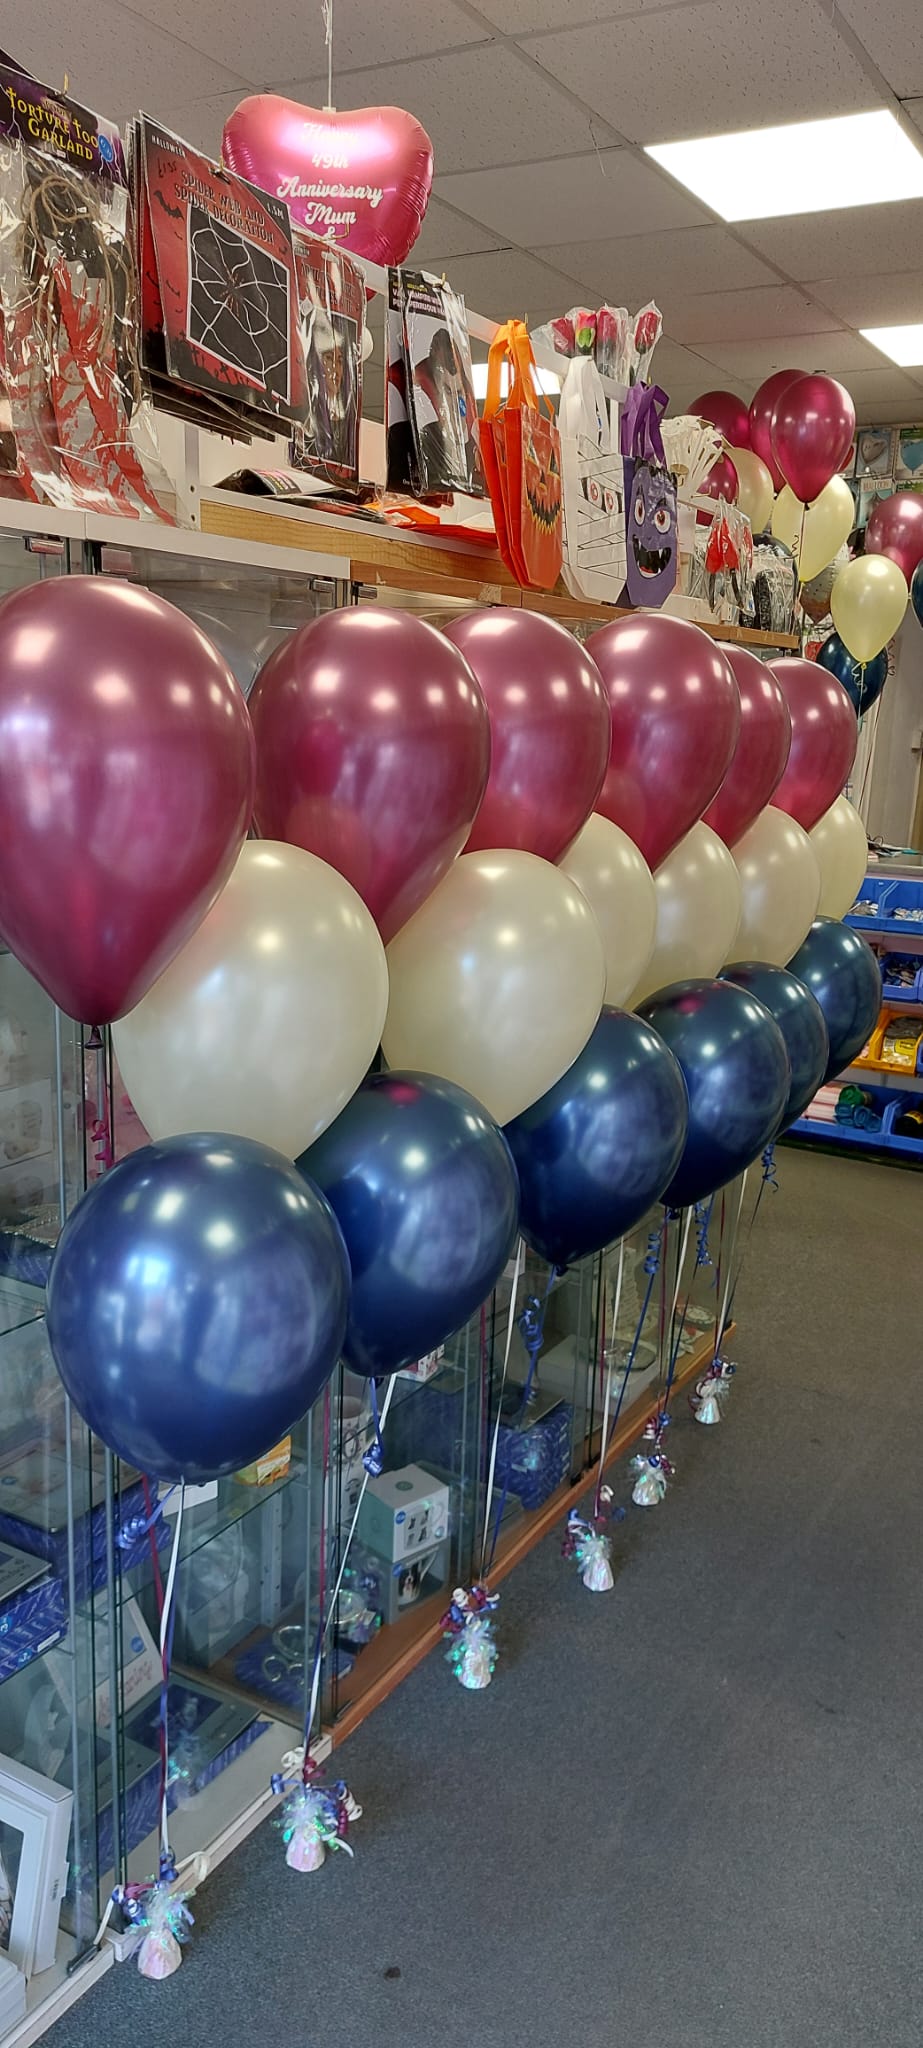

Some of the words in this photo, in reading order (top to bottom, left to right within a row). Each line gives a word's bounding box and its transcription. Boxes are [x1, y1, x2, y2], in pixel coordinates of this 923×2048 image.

[6, 86, 70, 134] TORTURE
[73, 118, 99, 149] TOO
[28, 117, 93, 161] GARLAND
[311, 152, 349, 169] 49th
[173, 183, 210, 213] SPIDER
[213, 204, 275, 244] DECORATION
[182, 171, 215, 199] SPIDER
[245, 205, 265, 227] AND
[276, 175, 384, 208] Anniversary
[304, 201, 357, 225] Mum
